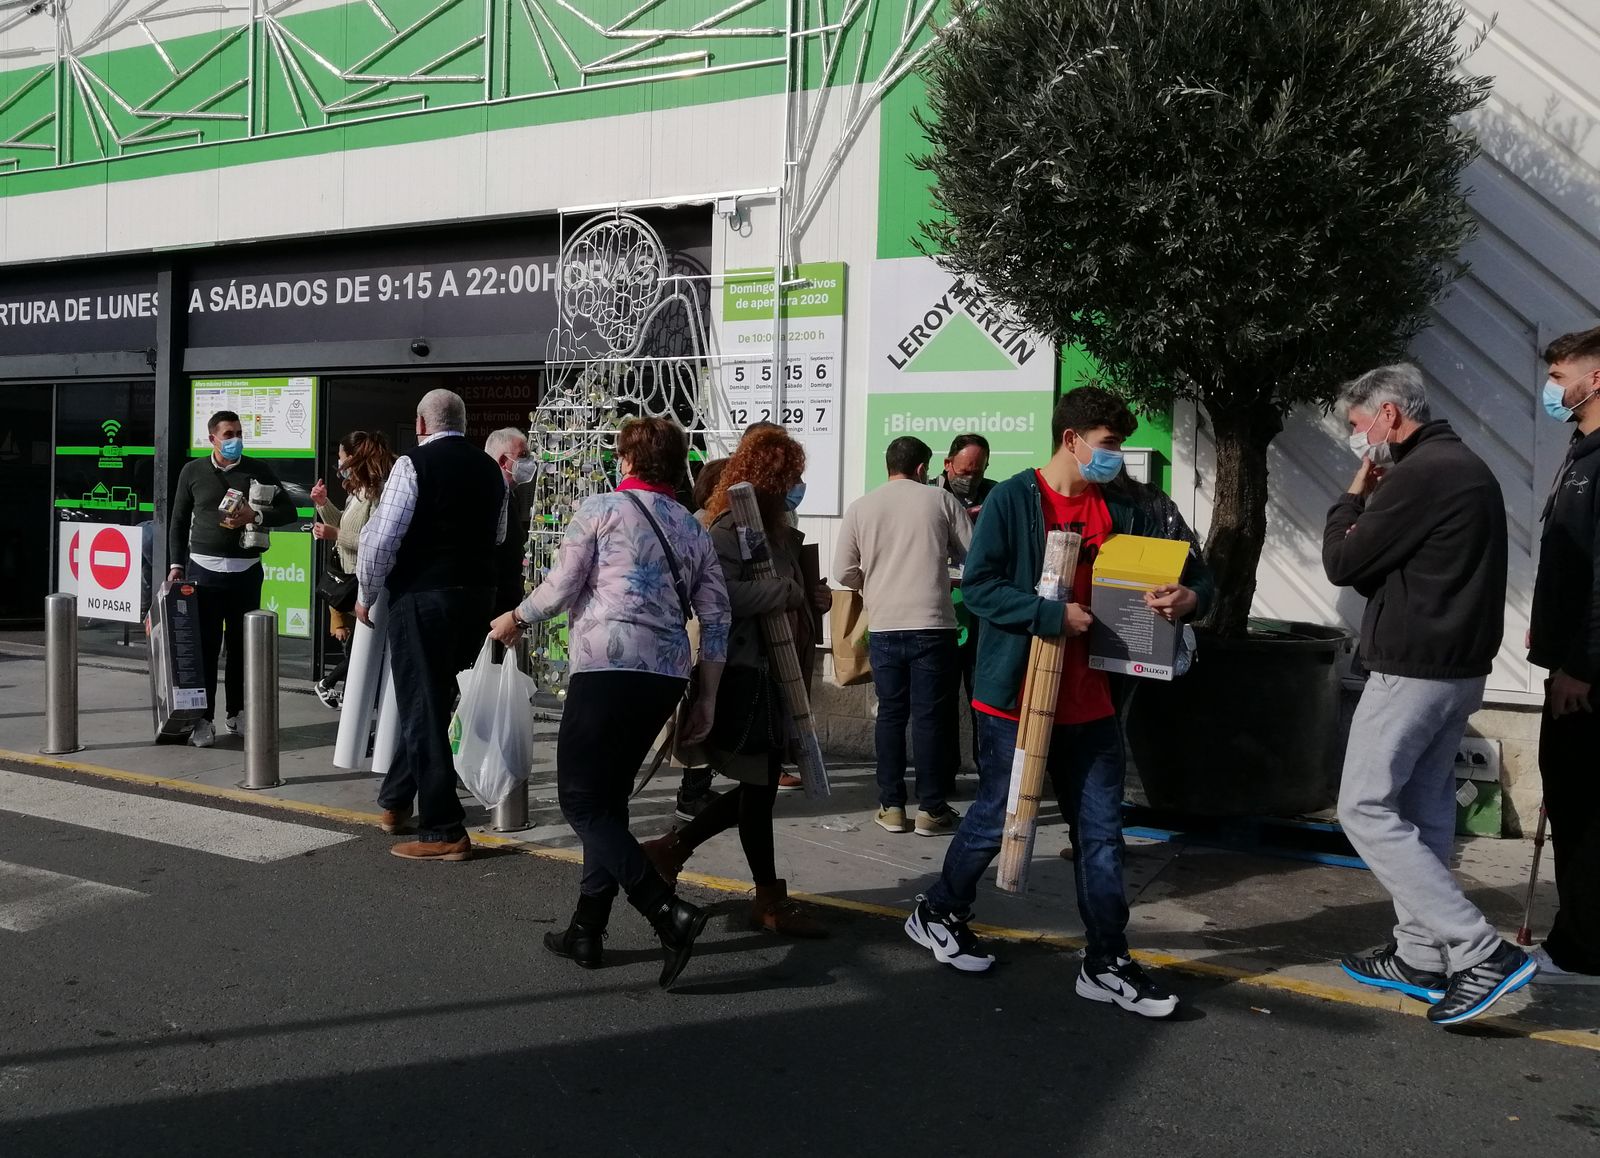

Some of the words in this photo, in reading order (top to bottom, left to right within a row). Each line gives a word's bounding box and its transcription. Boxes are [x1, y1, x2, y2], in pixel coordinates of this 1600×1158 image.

[188, 289, 204, 314] A
[210, 280, 328, 312] SÁBADOS
[336, 276, 371, 304] DE
[377, 271, 433, 301] 9:15
[438, 269, 459, 298] A
[65, 297, 91, 321] DE
[736, 299, 749, 309] de
[750, 295, 798, 309] aperura
[800, 293, 829, 305] 2020
[886, 294, 954, 370] LEROY
[947, 278, 1035, 366] MERLIN
[738, 334, 750, 343] De
[788, 331, 816, 341] 22:00
[819, 330, 825, 340] h
[735, 366, 745, 382] 5
[761, 365, 772, 381] 5
[784, 365, 803, 380] 15
[816, 363, 827, 379] 6
[730, 409, 748, 424] 12
[760, 408, 771, 422] 2
[782, 408, 804, 424] 29
[815, 407, 826, 423] 7
[884, 411, 1035, 436] ¡Bienvenidos!
[88, 597, 101, 609] NO
[102, 599, 131, 612] PASAR
